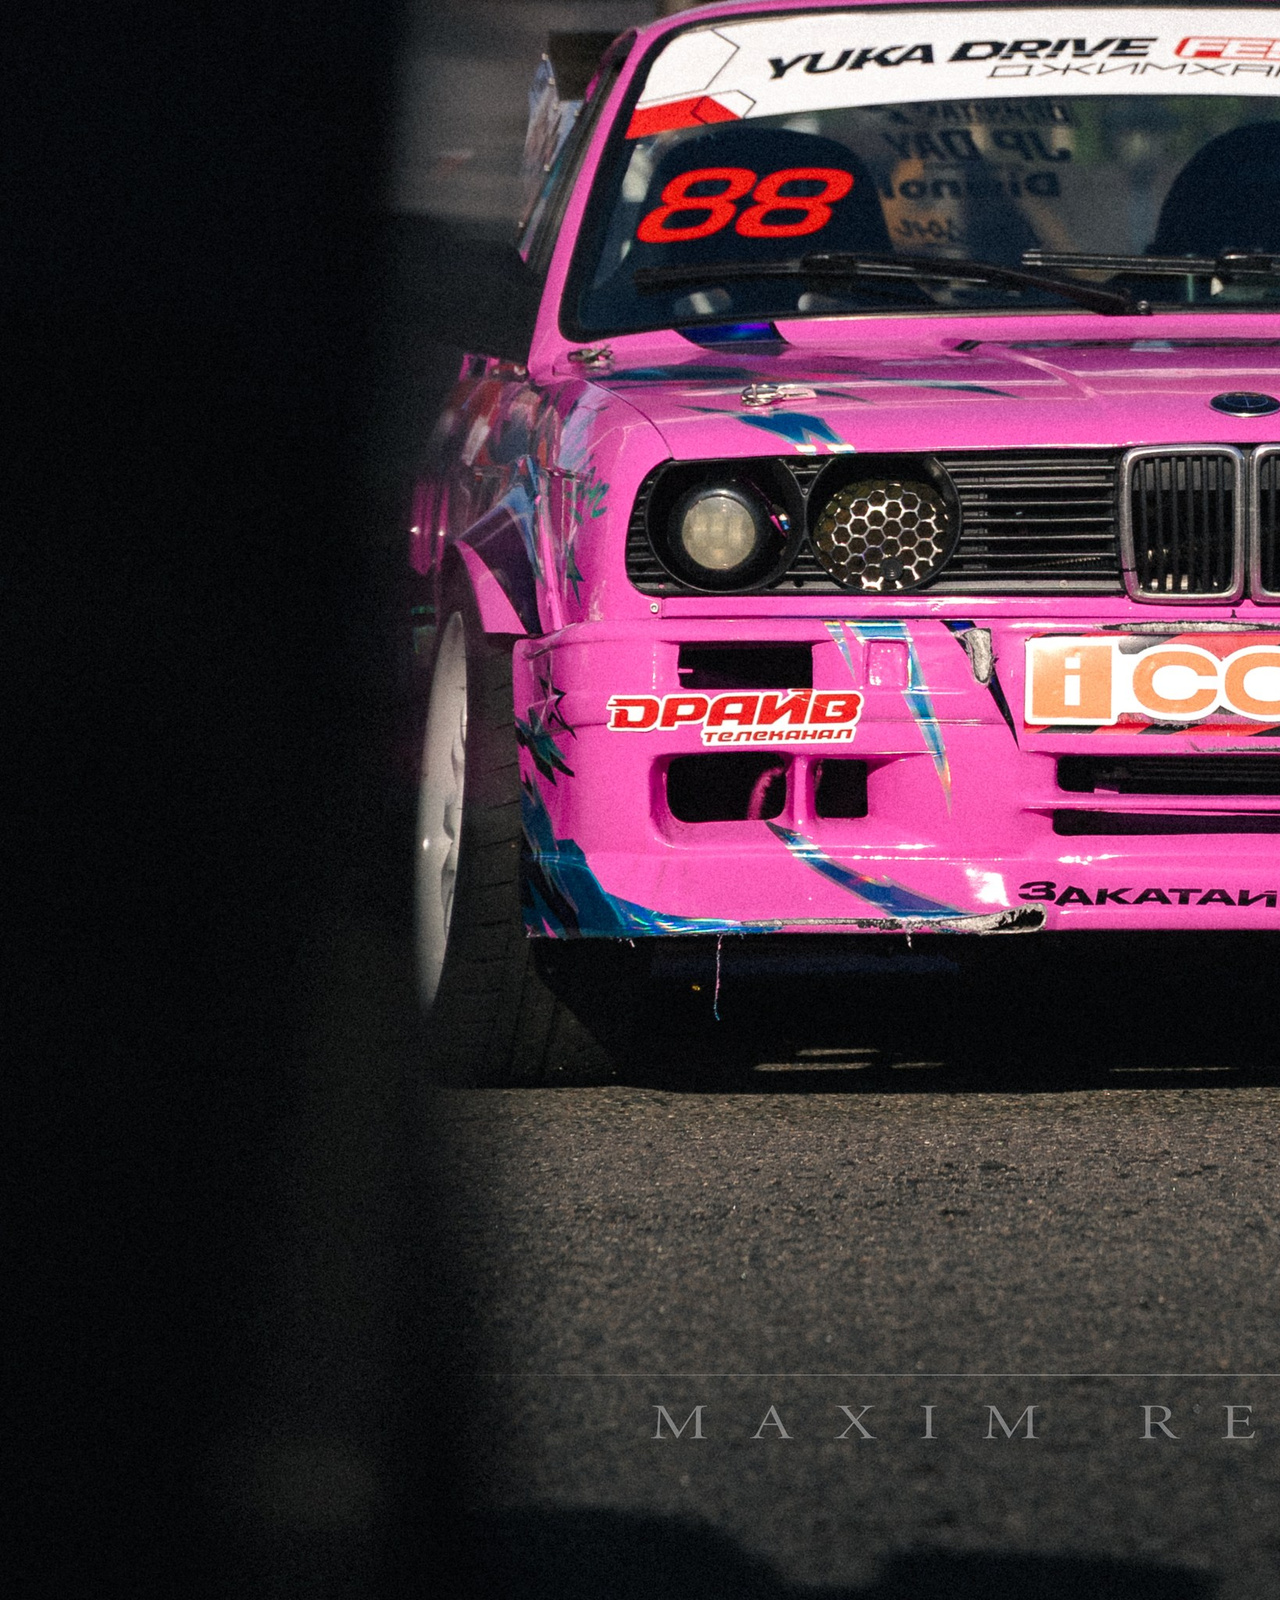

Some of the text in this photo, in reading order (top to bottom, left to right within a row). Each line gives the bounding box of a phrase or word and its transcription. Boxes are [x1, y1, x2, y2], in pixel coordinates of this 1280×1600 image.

[768, 43, 934, 80] YUKA
[948, 37, 1158, 63] DRIVE
[636, 167, 854, 243] 88
